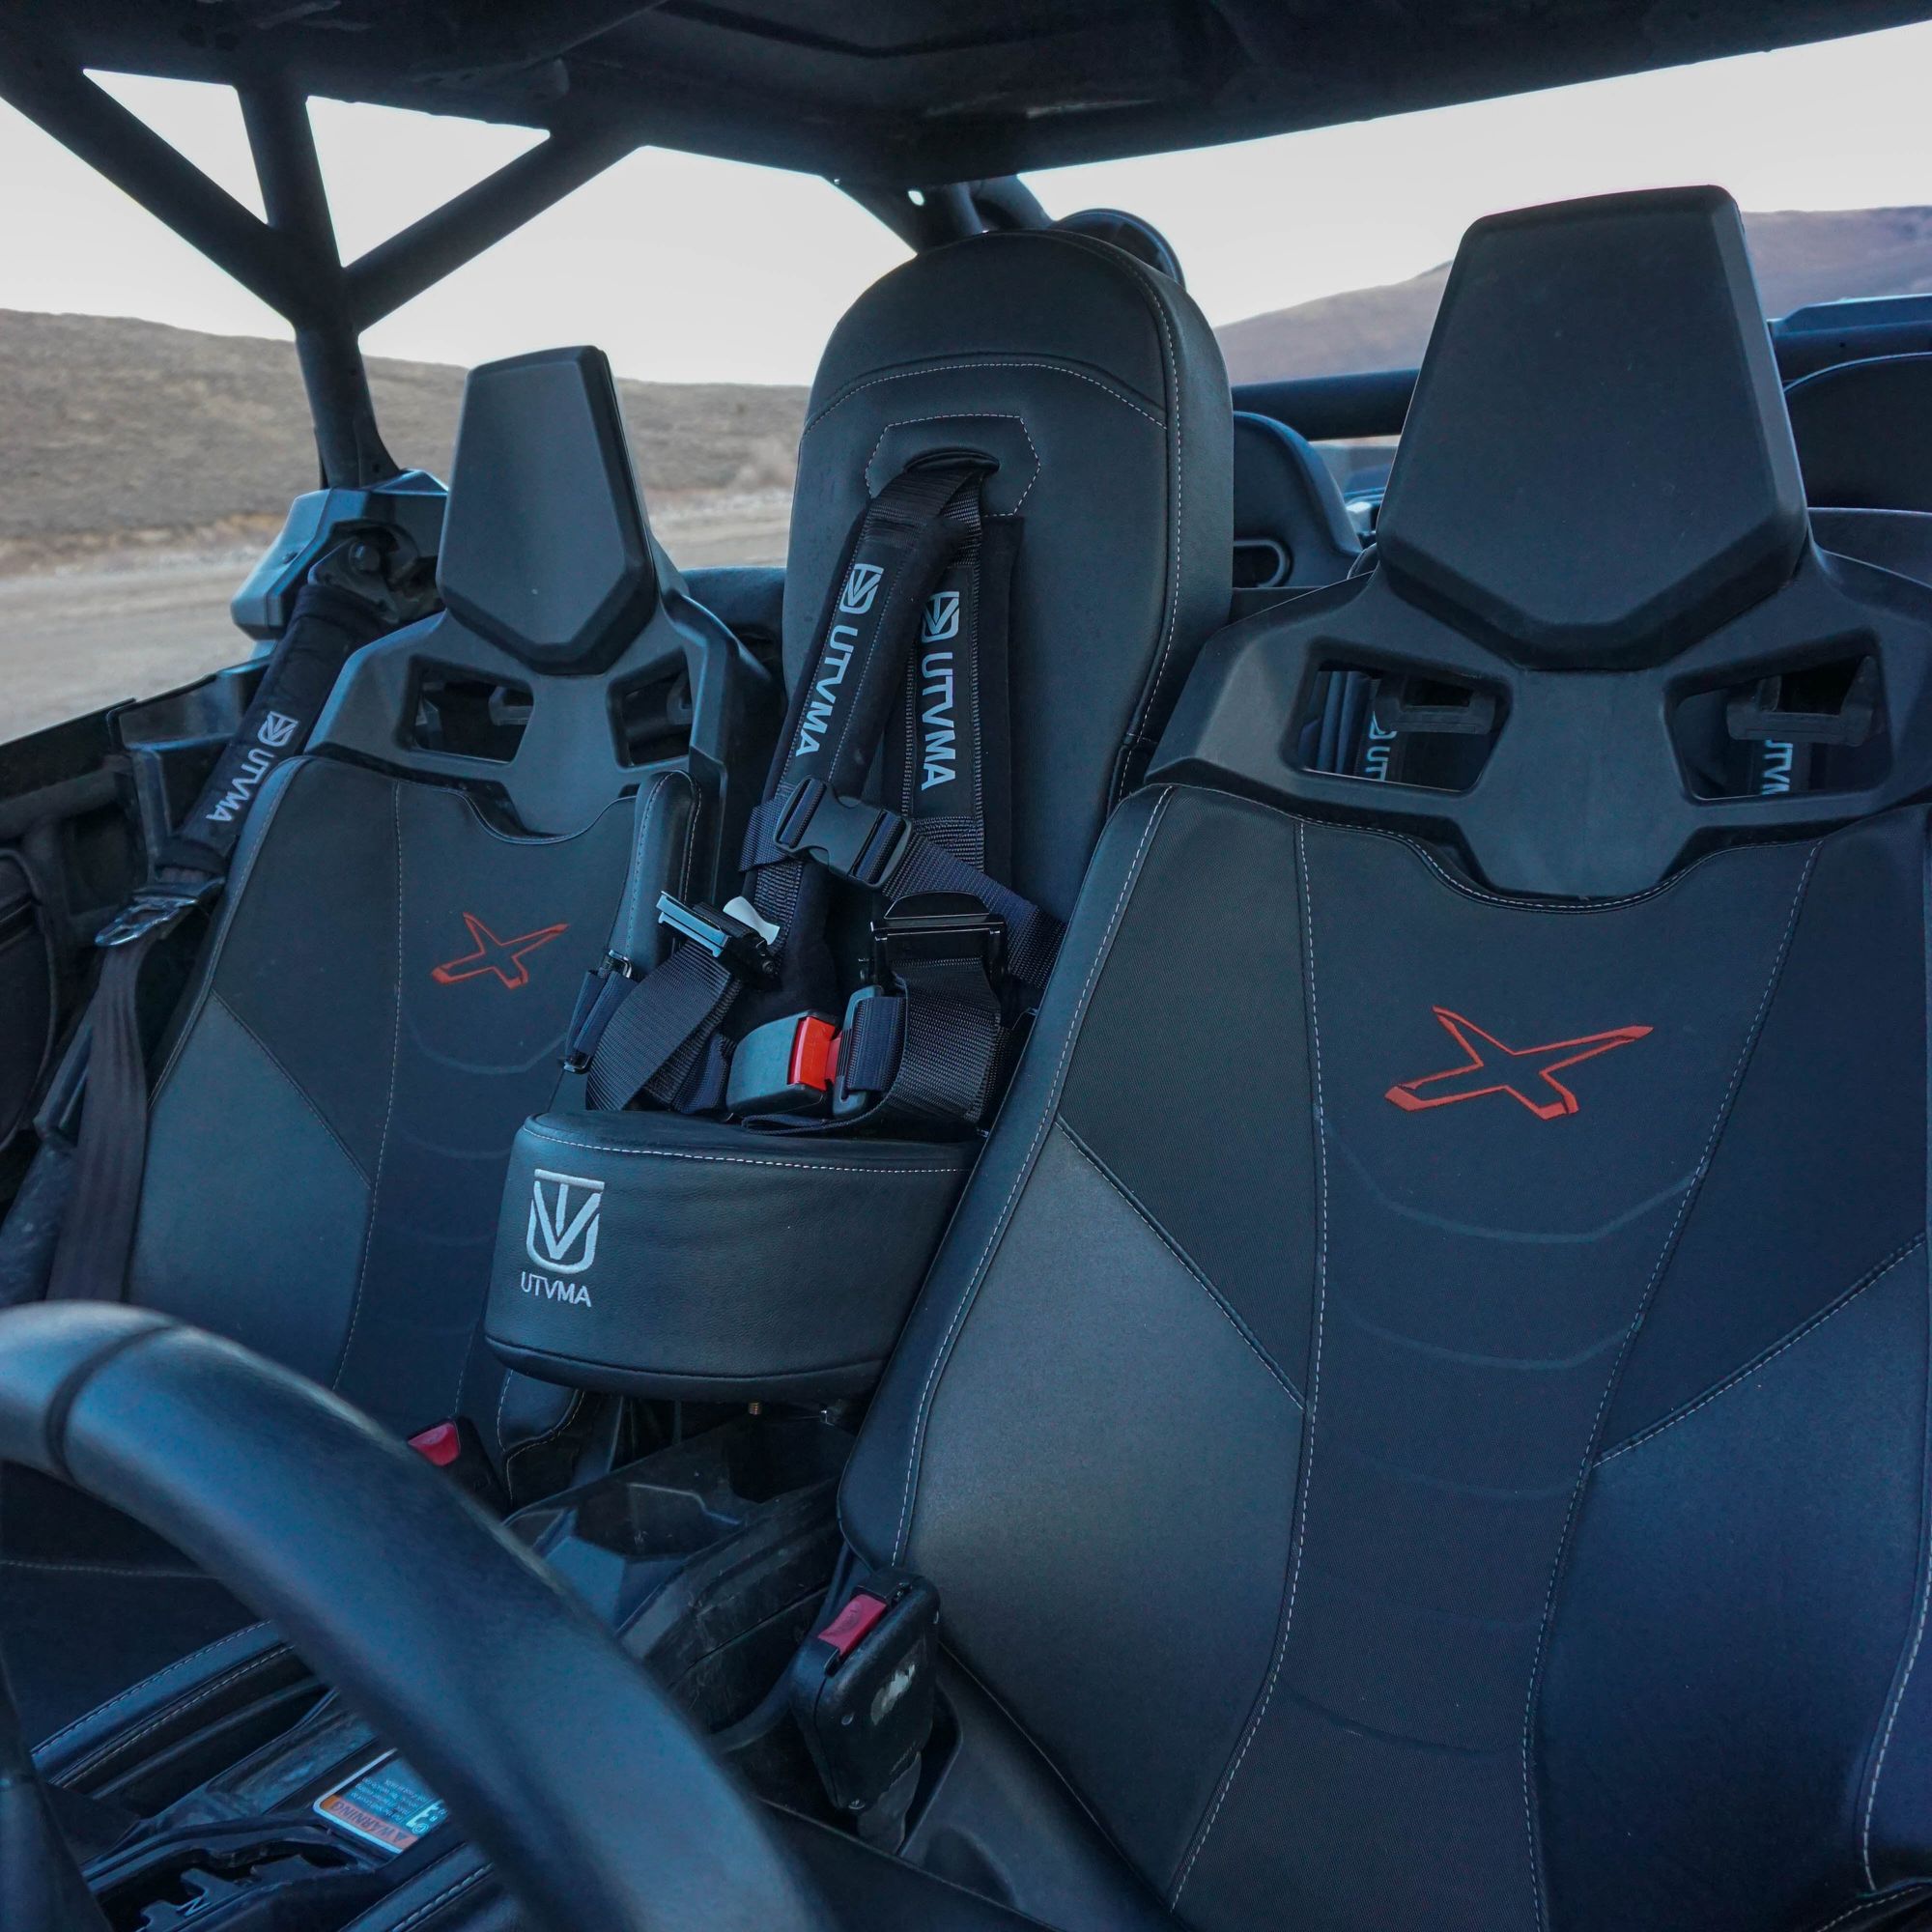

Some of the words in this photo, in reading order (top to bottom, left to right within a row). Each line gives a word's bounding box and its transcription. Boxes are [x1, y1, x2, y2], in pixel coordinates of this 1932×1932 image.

[795, 625, 858, 757] UTVMA
[922, 652, 956, 791] UTVMA
[206, 748, 275, 821] UTVMA
[521, 1270, 592, 1308] UTVMA
[330, 1801, 396, 1838] WARNING
